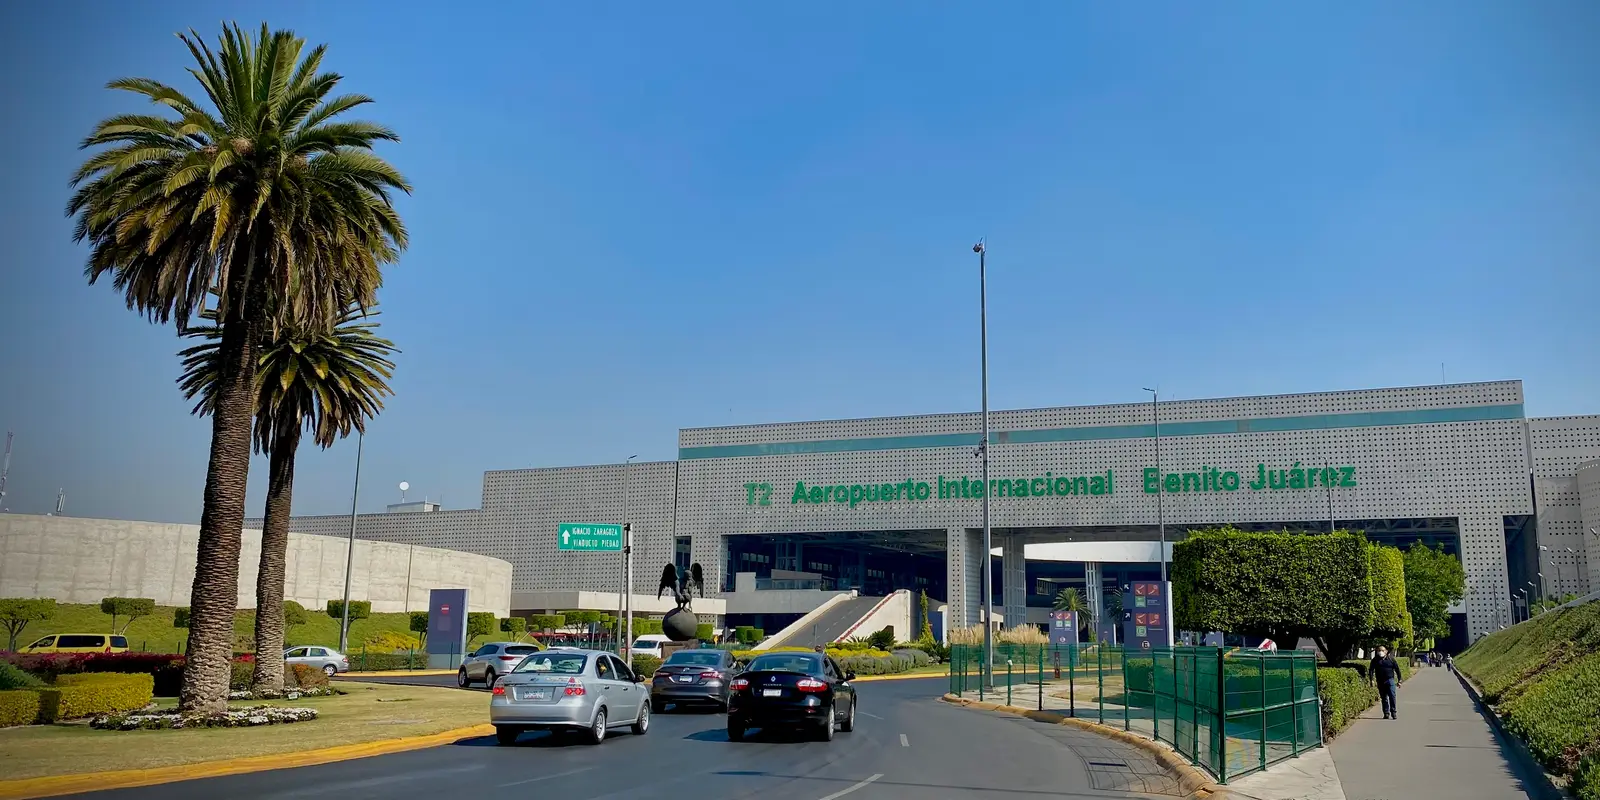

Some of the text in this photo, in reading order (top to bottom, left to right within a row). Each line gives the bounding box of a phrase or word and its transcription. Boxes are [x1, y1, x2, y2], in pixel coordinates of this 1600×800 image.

[743, 461, 1357, 509] T2 Aeropuerto Internacional Benito Juárez
[572, 527, 618, 536] IGNACIO ZARAGOZA
[601, 539, 619, 548] PIEDAD
